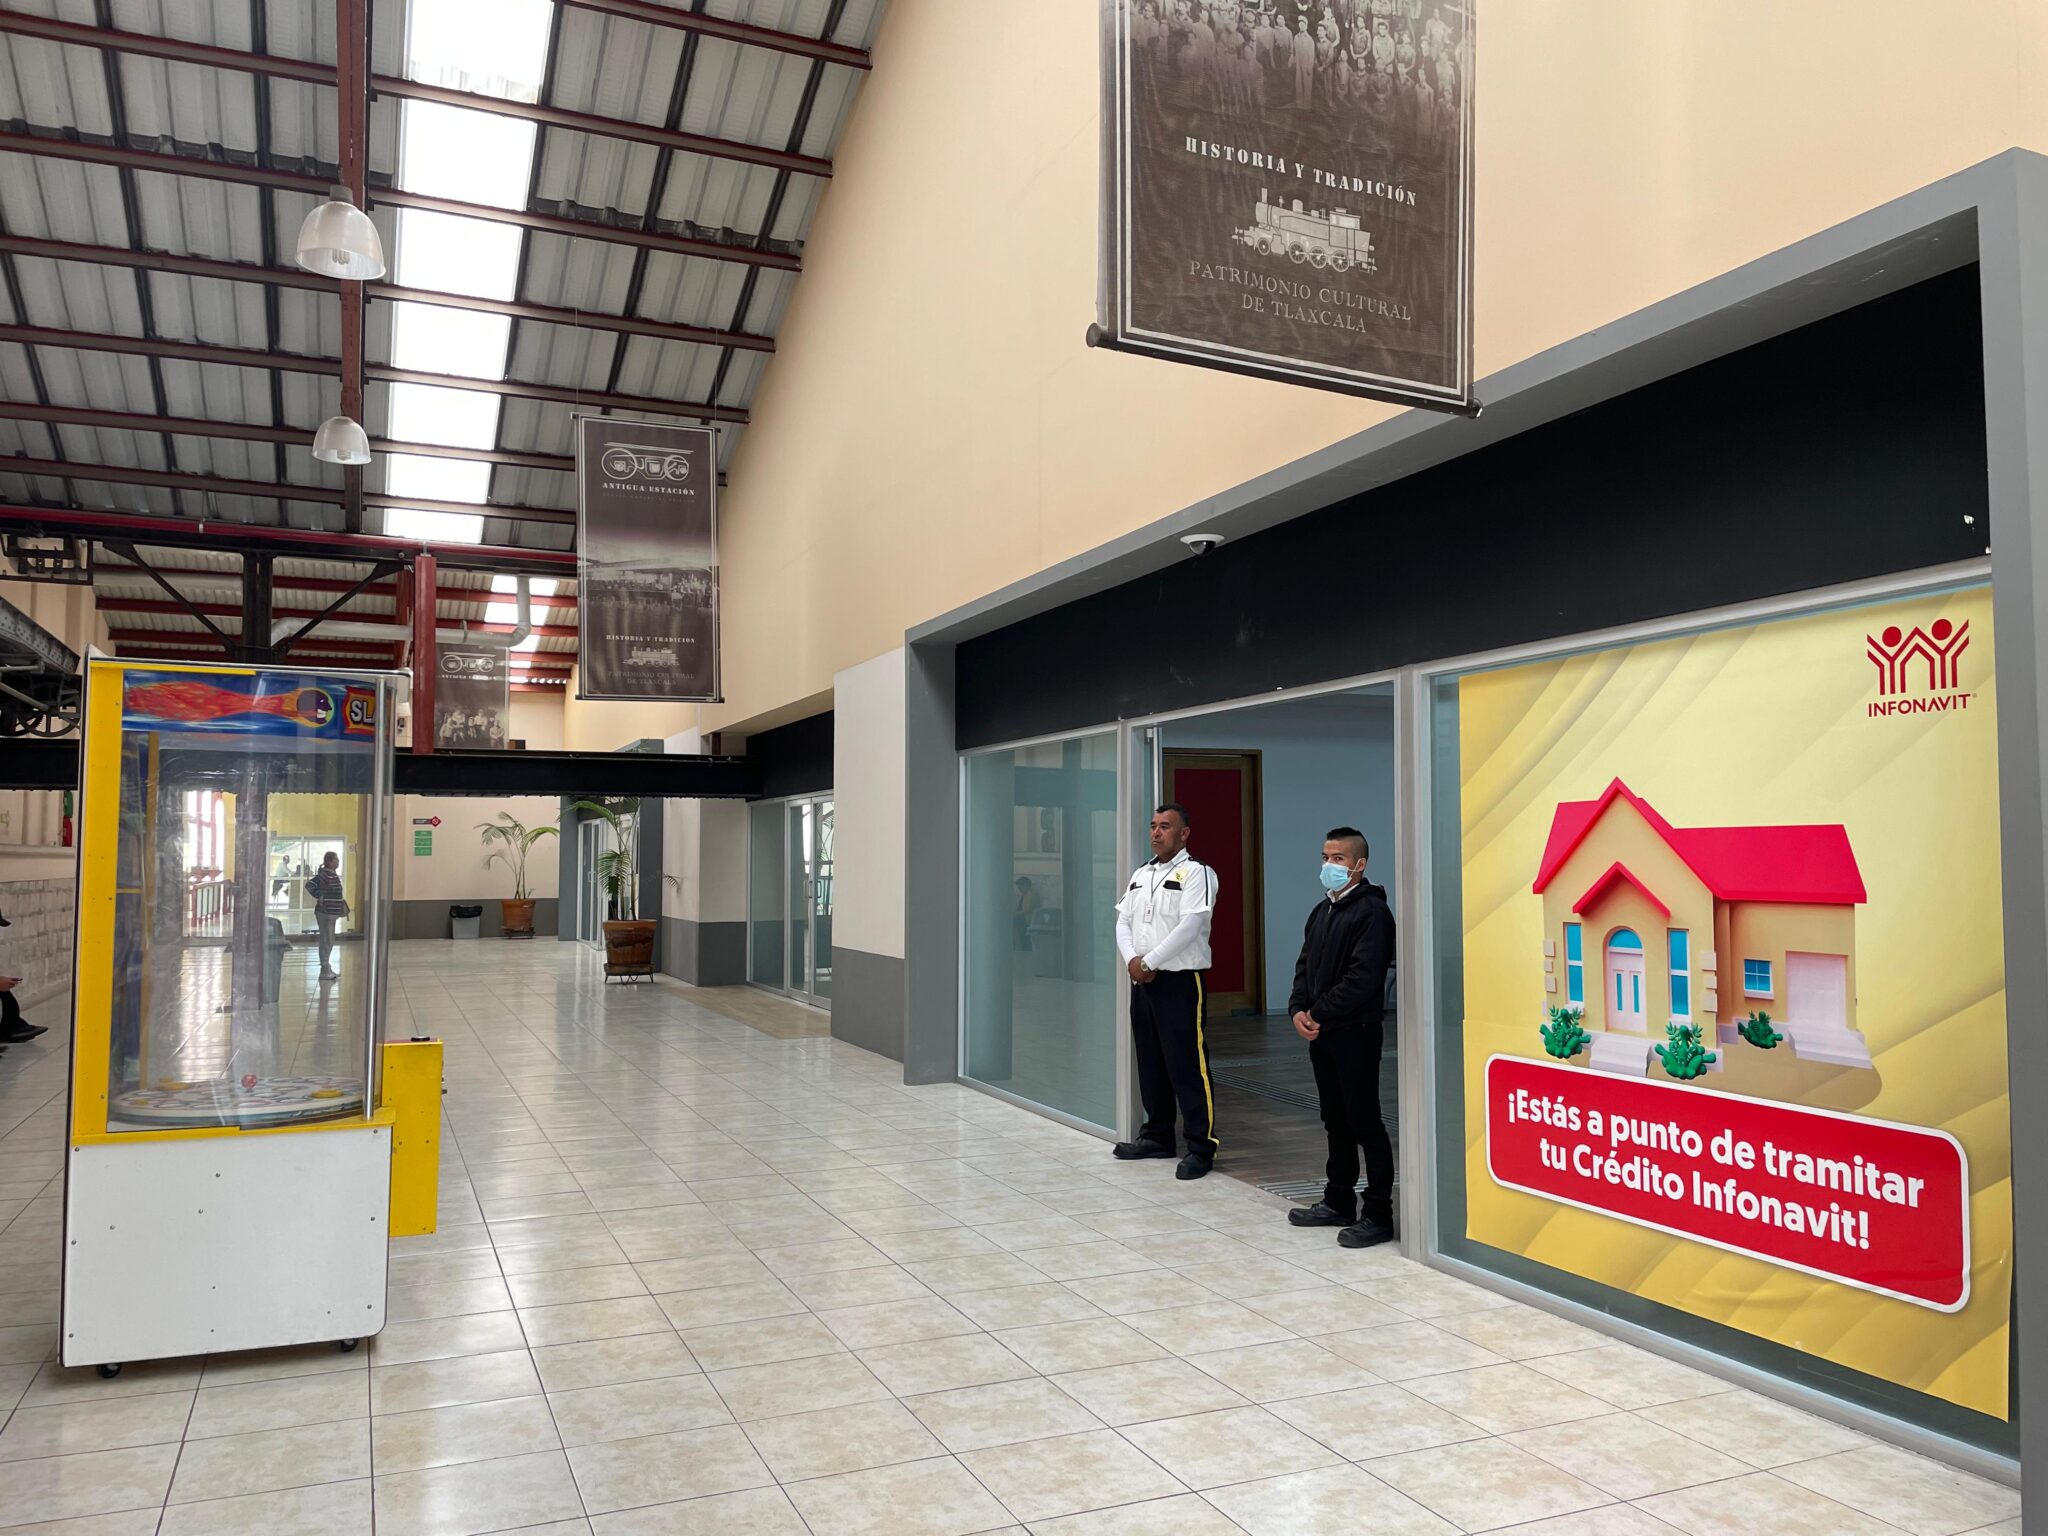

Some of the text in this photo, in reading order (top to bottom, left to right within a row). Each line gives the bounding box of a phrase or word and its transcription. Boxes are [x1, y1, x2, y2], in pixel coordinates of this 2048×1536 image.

[1185, 136, 1417, 206] HISTORIA Y TRADICIÓN
[1189, 261, 1412, 321] PATRIMONIO CULTURAL
[1241, 293, 1367, 334] DE TLAXCALA
[602, 482, 645, 492] ANTIGUA
[606, 634, 644, 642] HISTORIA
[1868, 693, 1971, 718] INFONAVIT
[1508, 1088, 1924, 1208] ¡Estás a punto de tramitar
[1540, 1137, 1870, 1250] tu Crédito Infonavit!
